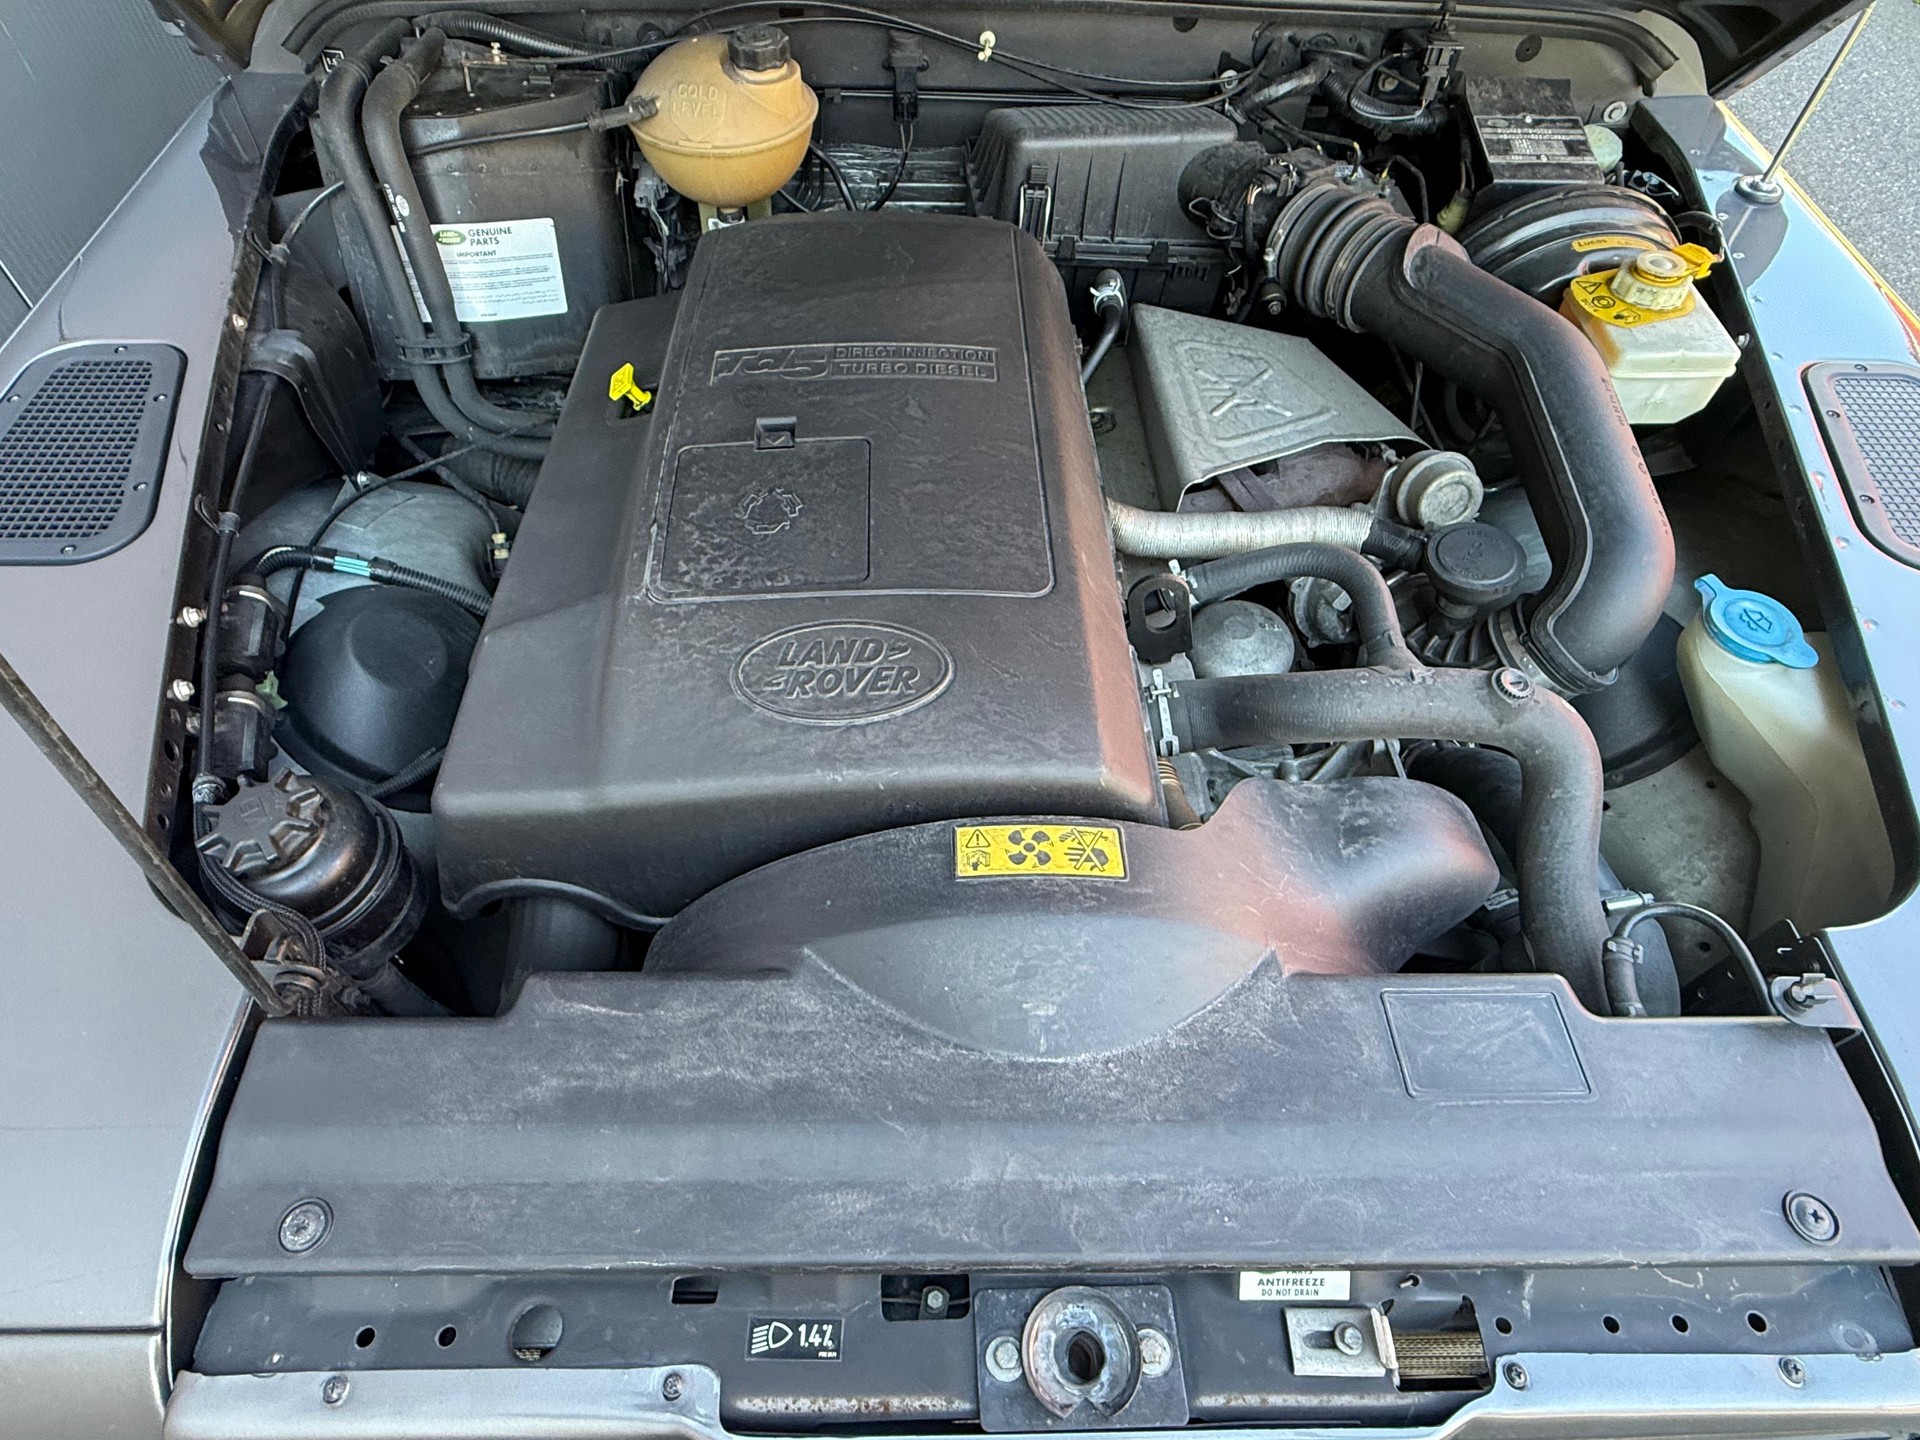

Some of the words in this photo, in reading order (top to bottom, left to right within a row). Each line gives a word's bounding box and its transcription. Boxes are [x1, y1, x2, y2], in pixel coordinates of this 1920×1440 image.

[677, 83, 719, 100] COLD
[672, 101, 721, 118] LEVEL
[467, 226, 513, 238] GENUINE
[469, 236, 500, 247] PARTS
[456, 249, 497, 258] IMPORTANT
[836, 346, 896, 359] DIRECT
[901, 347, 991, 361] INJECTION
[839, 361, 909, 376] TURBO
[914, 362, 988, 378] DIESEL
[776, 637, 885, 670] LAND
[784, 665, 920, 699] ROVER
[1257, 1278, 1326, 1287] ANTIFREEZE
[1261, 1288, 1273, 1297] DO
[1275, 1288, 1292, 1297] NOT
[1294, 1288, 1320, 1297] DRAIN
